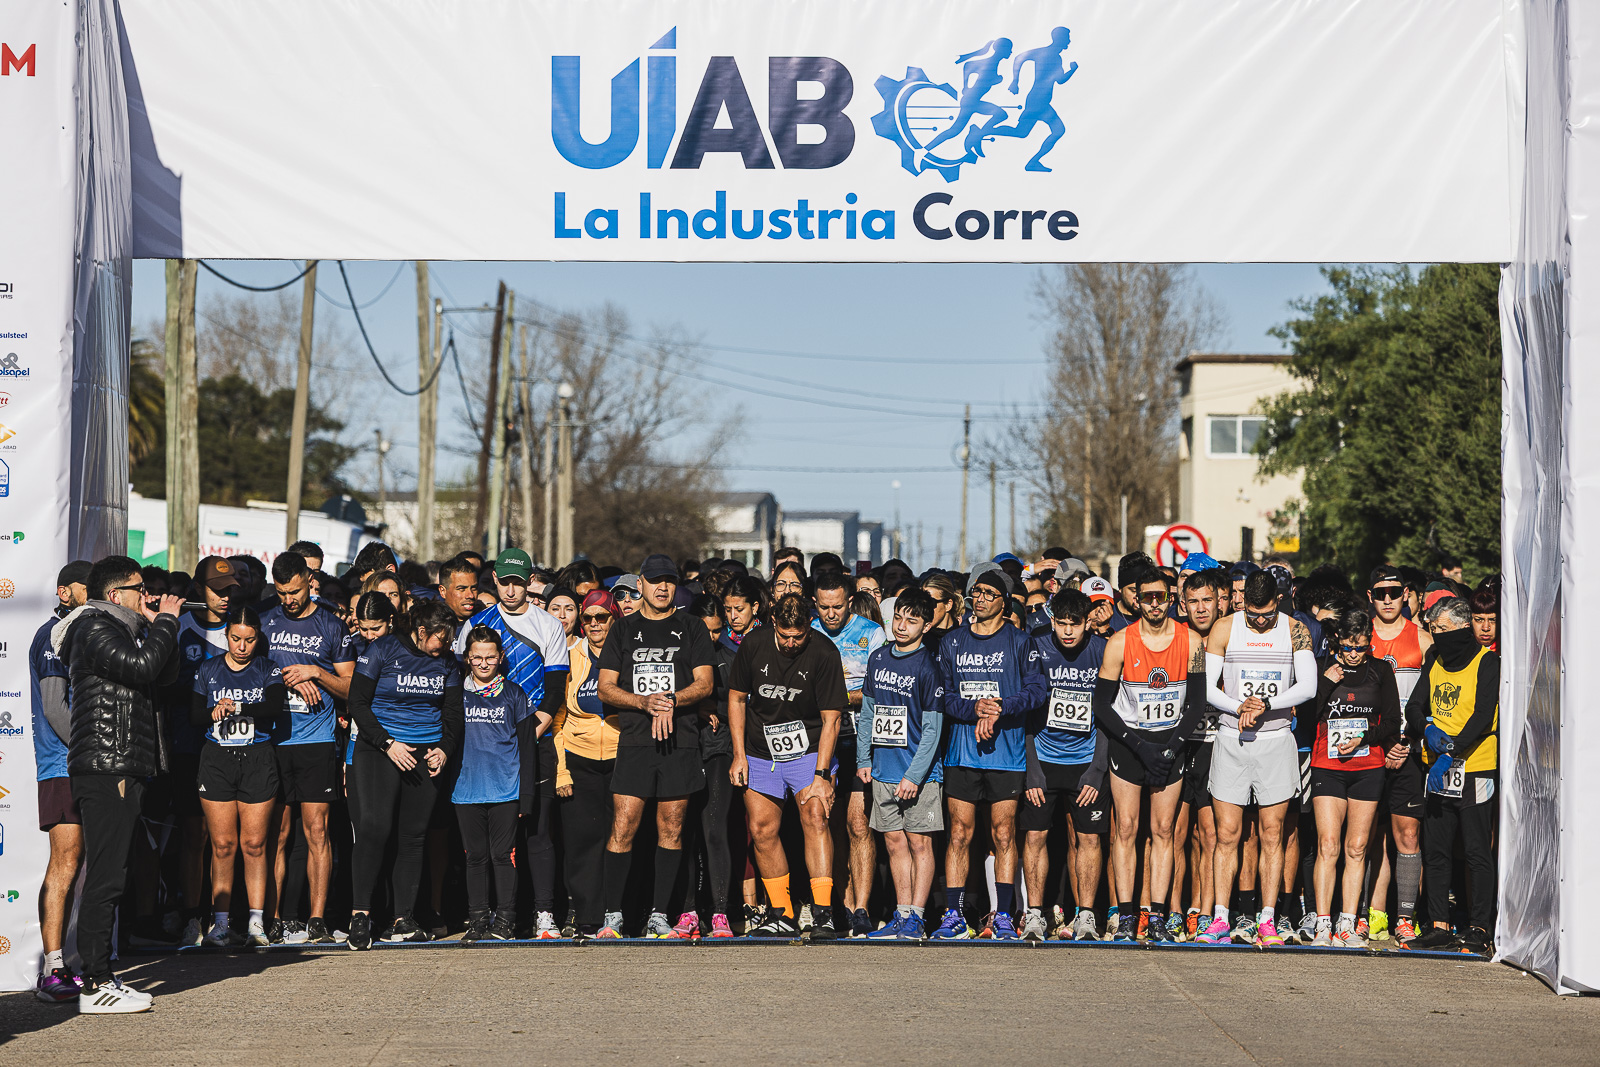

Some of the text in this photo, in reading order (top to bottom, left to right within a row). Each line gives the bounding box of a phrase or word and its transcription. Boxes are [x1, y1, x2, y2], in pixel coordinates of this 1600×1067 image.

[1, 43, 36, 76] M
[554, 190, 1080, 241] La Industria Corre
[277, 645, 302, 653] Industria
[302, 648, 320, 658] Corre
[632, 646, 681, 662] GRT
[637, 675, 671, 693] 653
[758, 683, 803, 702] GRT
[1243, 681, 1278, 698] 349
[1444, 683, 1453, 691] Los
[1053, 702, 1088, 721] 692
[1142, 702, 1174, 720] 118
[1340, 704, 1374, 713] FCmax
[875, 718, 904, 735] 642
[772, 733, 804, 753] 691
